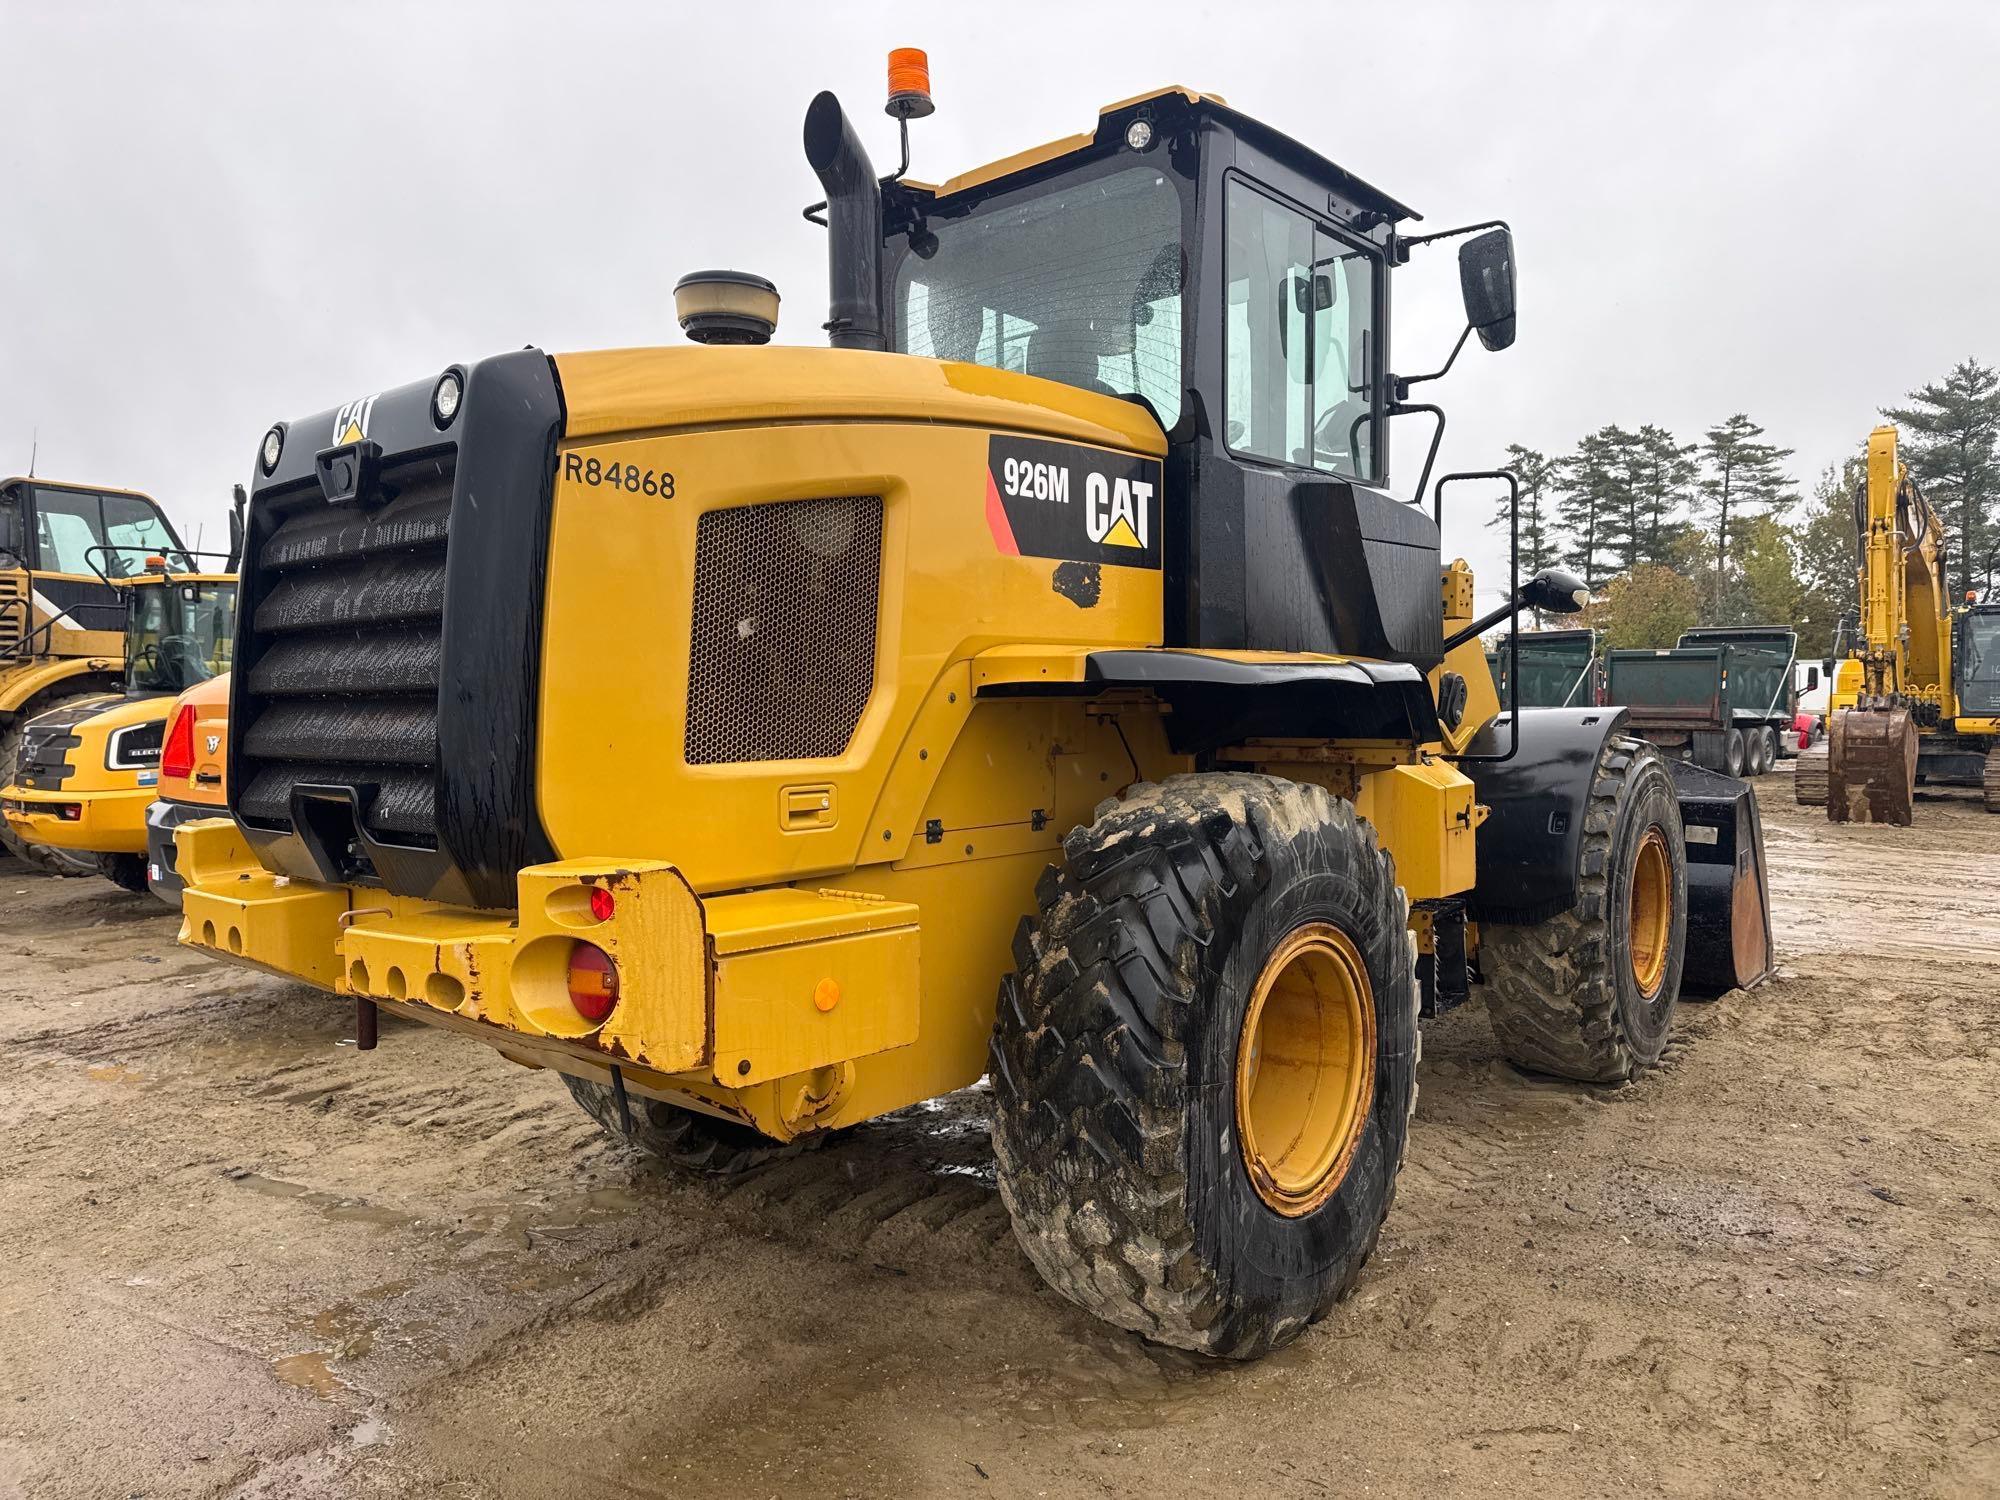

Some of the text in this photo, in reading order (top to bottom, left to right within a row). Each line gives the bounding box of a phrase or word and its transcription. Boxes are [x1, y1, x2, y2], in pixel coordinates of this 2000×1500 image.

[332, 392, 382, 447] CAT
[565, 453, 675, 499] R84868
[1004, 457, 1069, 503] 926M
[1085, 472, 1153, 549] CAT
